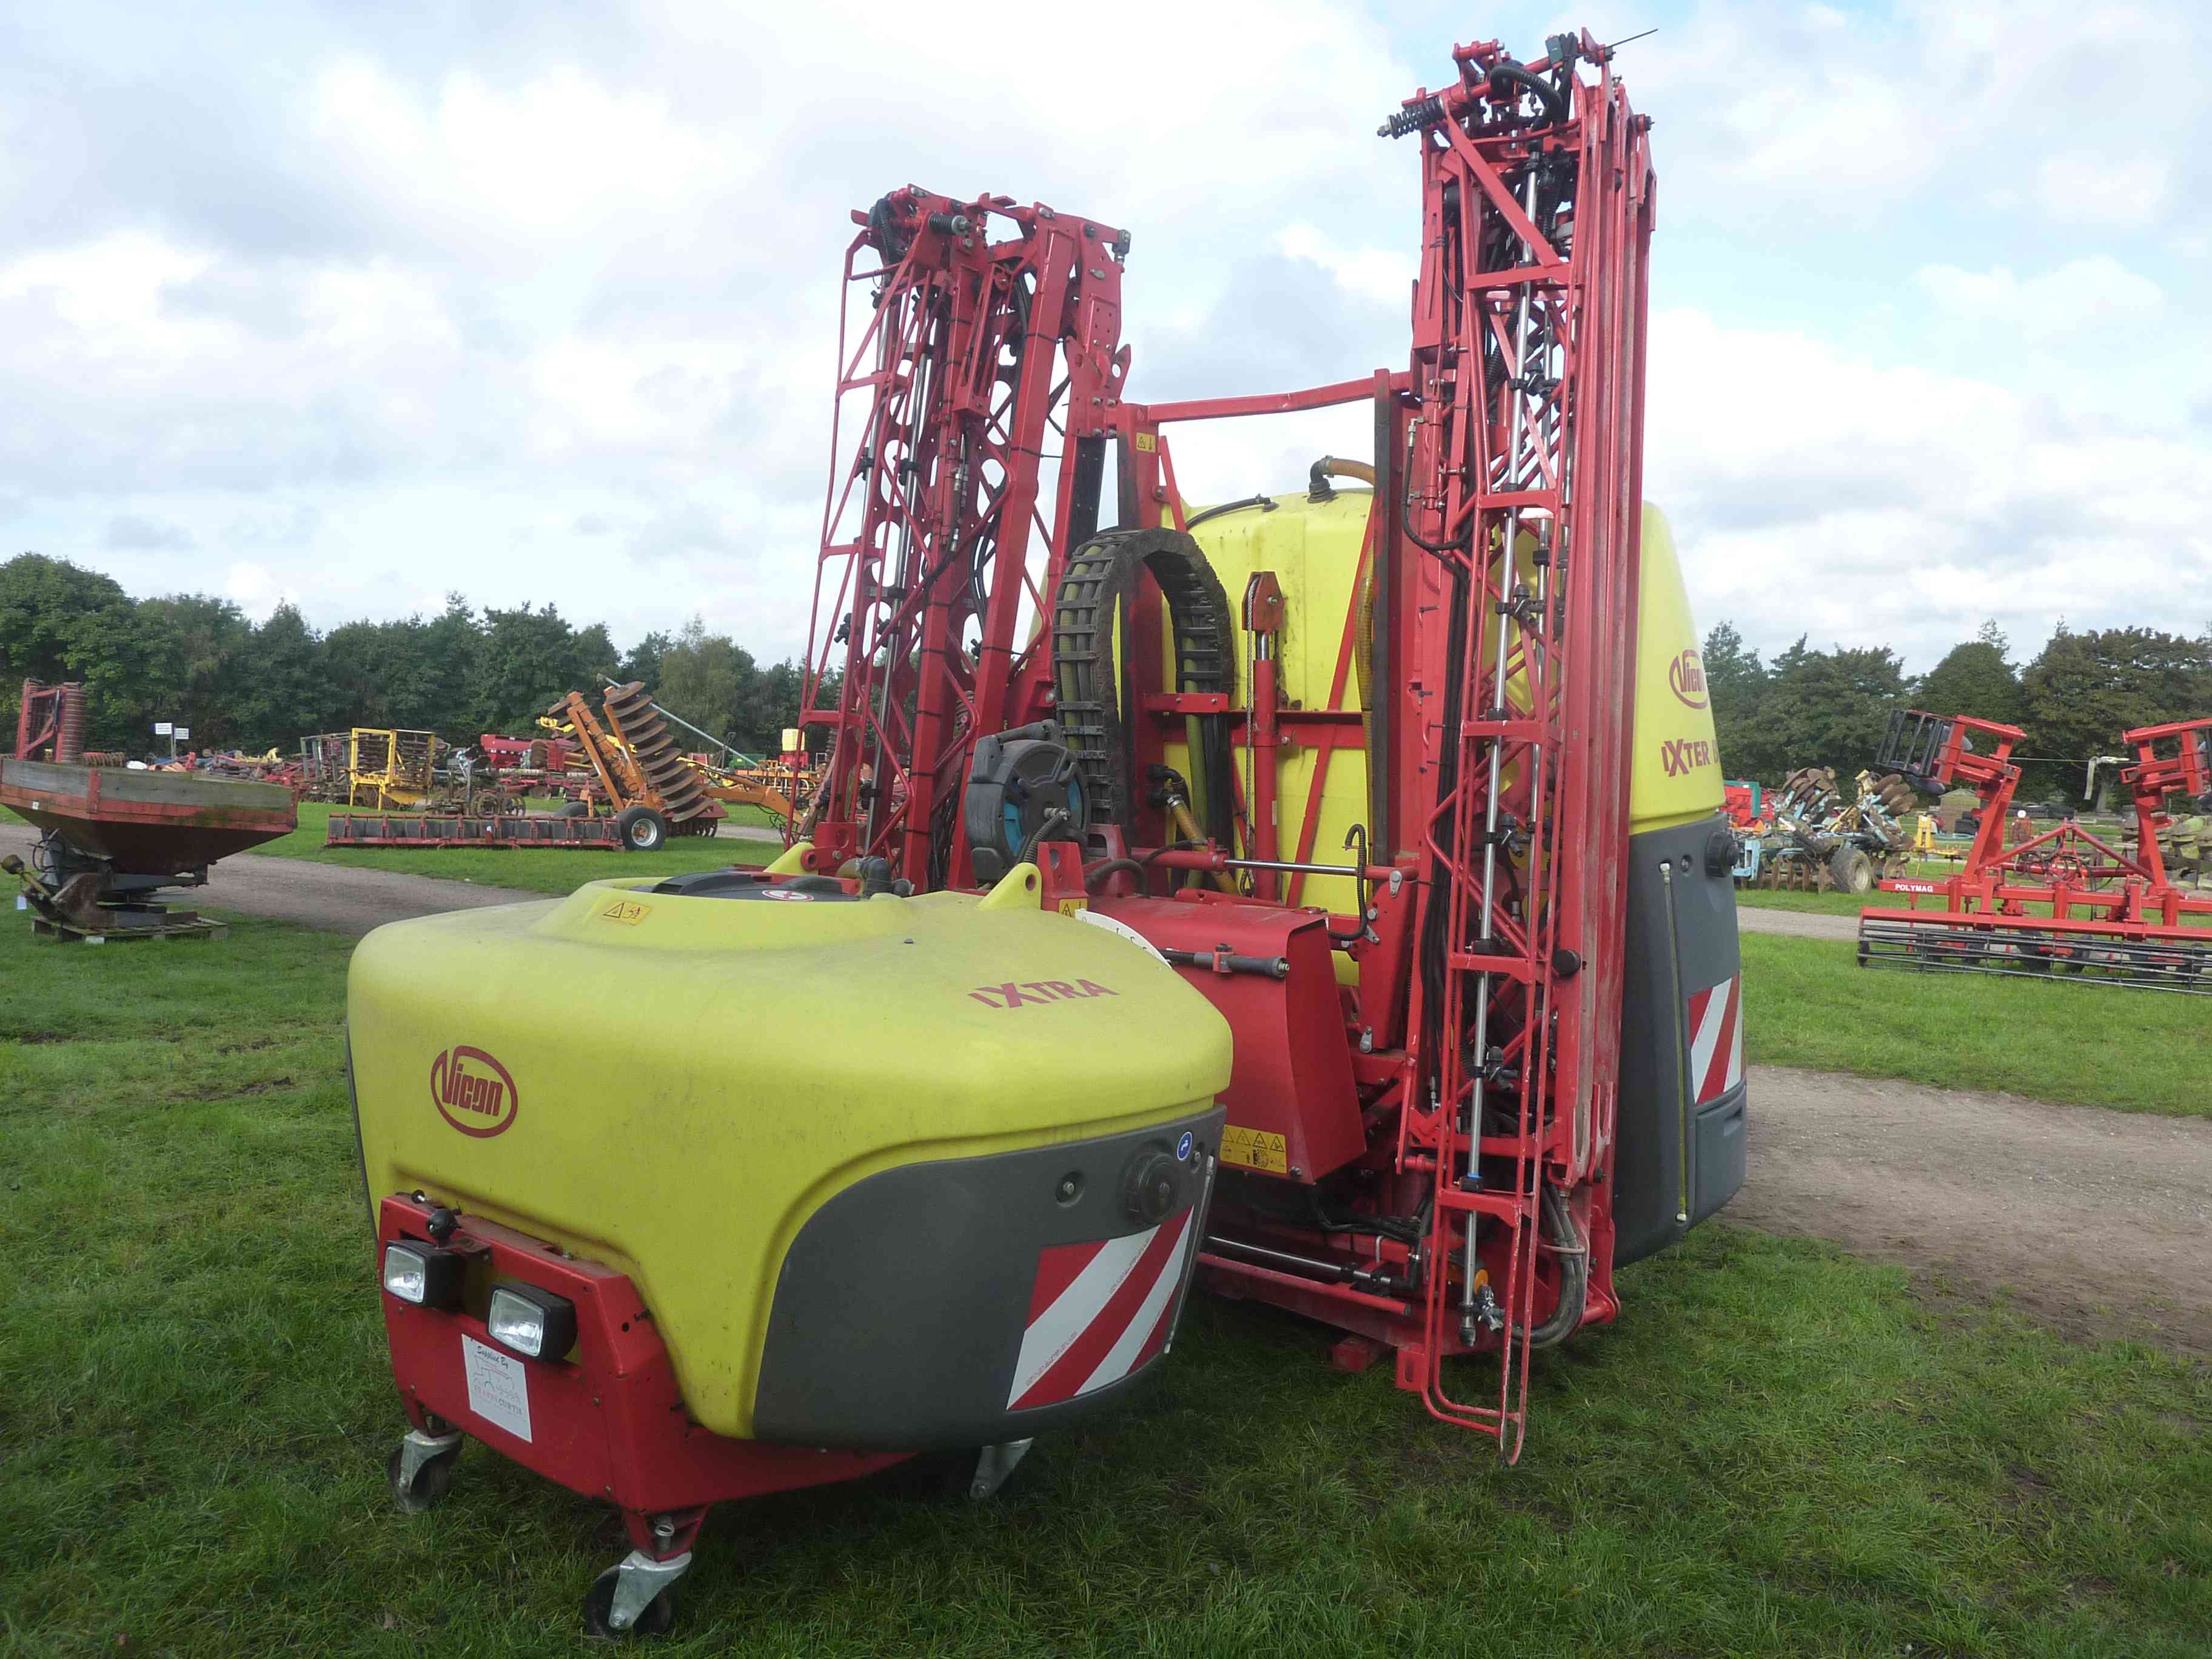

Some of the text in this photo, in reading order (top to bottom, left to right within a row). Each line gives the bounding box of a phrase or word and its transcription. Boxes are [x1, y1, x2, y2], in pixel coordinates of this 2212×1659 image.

[1661, 739, 1710, 777] IXTER
[1895, 883, 1934, 893] POLYMAG
[968, 979, 1120, 1008] IXTRA
[440, 1047, 506, 1118] Vicon
